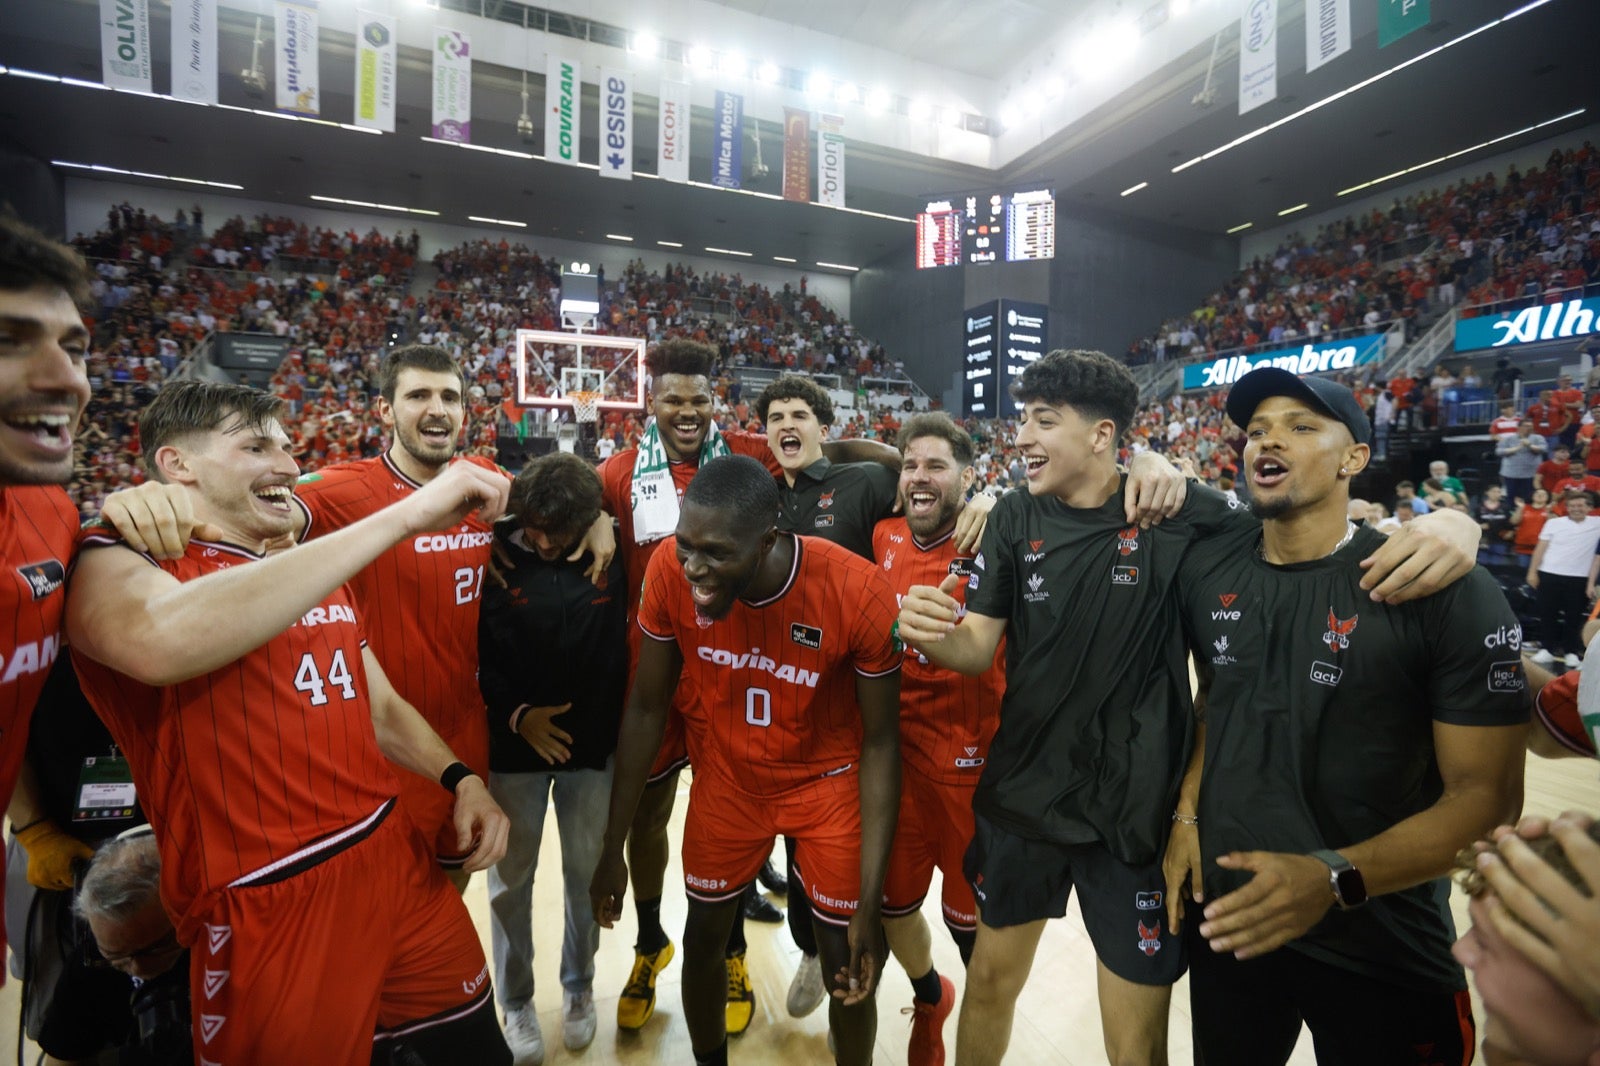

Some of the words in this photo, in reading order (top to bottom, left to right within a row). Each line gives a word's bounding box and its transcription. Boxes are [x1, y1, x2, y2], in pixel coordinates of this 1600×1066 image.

[284, 9, 300, 93] aeroprint
[554, 63, 573, 160] COVIRAN
[664, 101, 676, 160] RICOH
[719, 92, 734, 139] Motor
[718, 140, 732, 177] Mica
[823, 142, 838, 192] orion
[1492, 299, 1600, 347] Alh
[455, 565, 484, 606] 21
[1211, 609, 1241, 621] vive
[292, 647, 357, 708] 44
[696, 646, 821, 688] COVIRAN
[745, 686, 772, 728] 0
